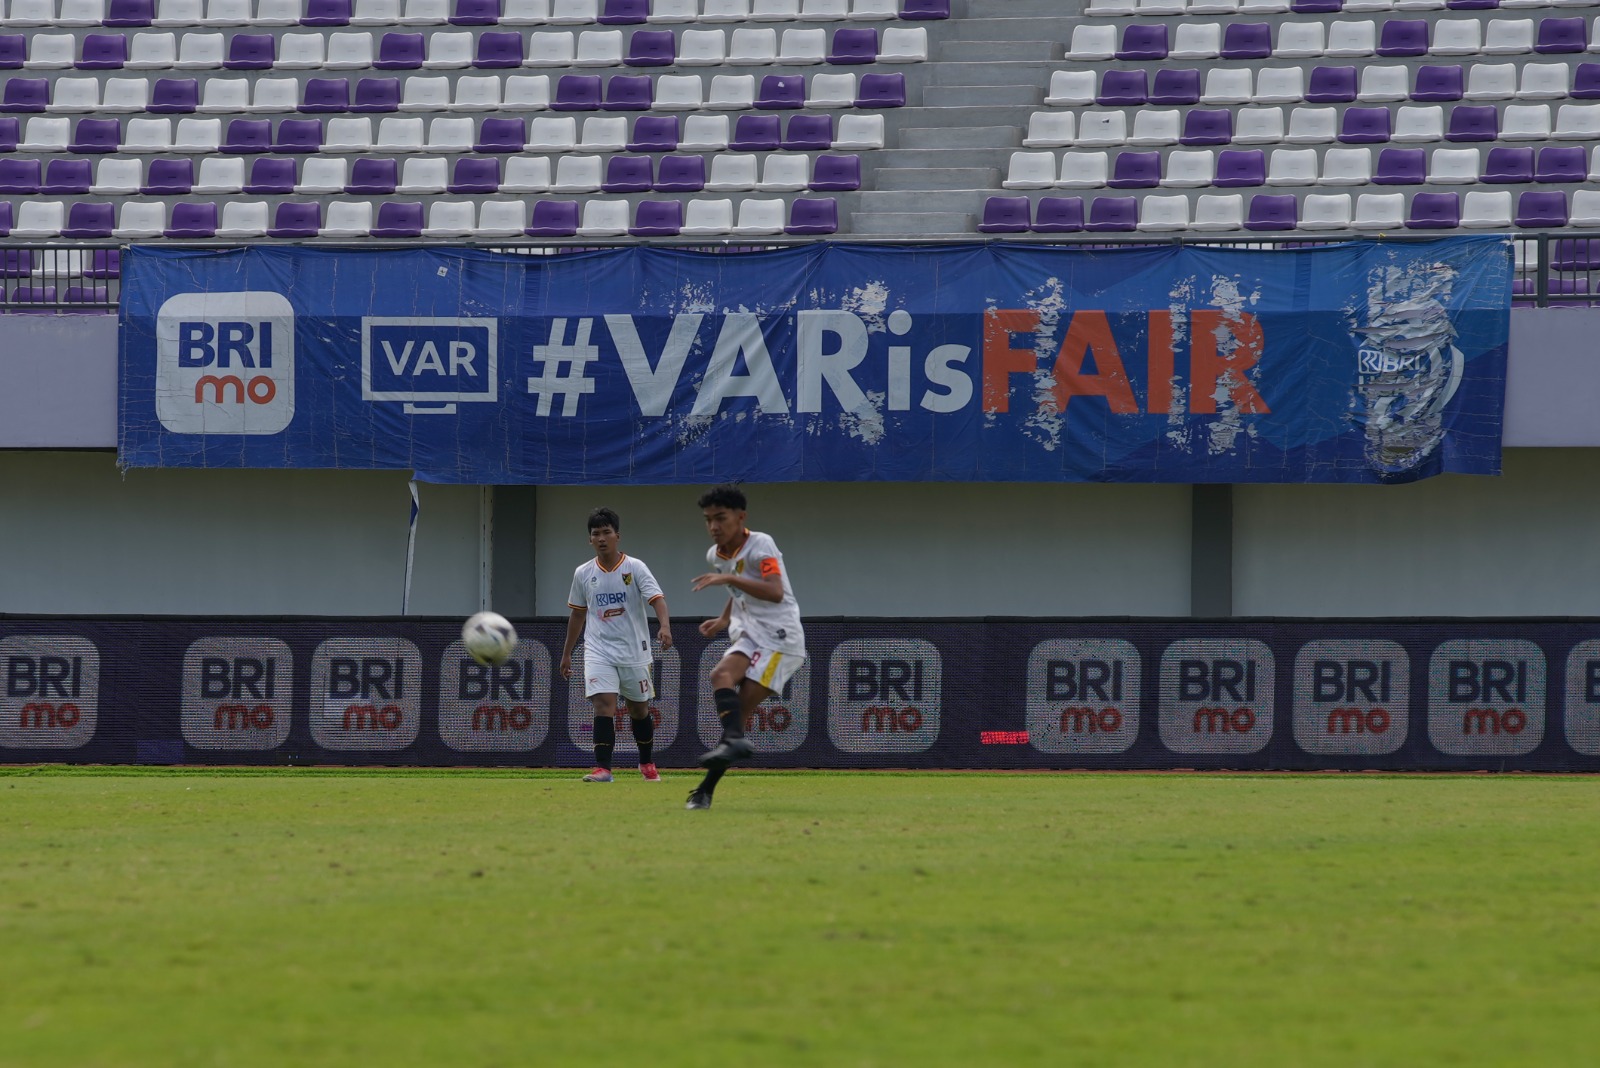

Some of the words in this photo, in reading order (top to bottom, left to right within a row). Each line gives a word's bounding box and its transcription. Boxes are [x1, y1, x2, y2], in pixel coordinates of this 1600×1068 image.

[178, 321, 272, 369] BRI
[380, 340, 478, 377] VAR
[195, 375, 276, 405] mo
[608, 592, 627, 604] BRI
[6, 656, 82, 698] BRI
[201, 657, 276, 700] BRI
[329, 657, 404, 700] BRI
[459, 659, 532, 701] BRI
[639, 679, 649, 694] 13
[848, 659, 922, 701] BRI
[1046, 660, 1123, 702] BRI
[1180, 660, 1257, 702] BRI
[1313, 660, 1392, 702] BRI
[1449, 660, 1527, 703] BRI
[19, 702, 81, 728] mo
[213, 704, 274, 730] mo
[342, 704, 403, 731] mo
[472, 705, 532, 731] mo
[861, 706, 922, 733] mo
[1059, 706, 1123, 734] mo
[1193, 706, 1256, 734] mo
[1327, 707, 1391, 735] mo
[1462, 707, 1527, 736] mo
